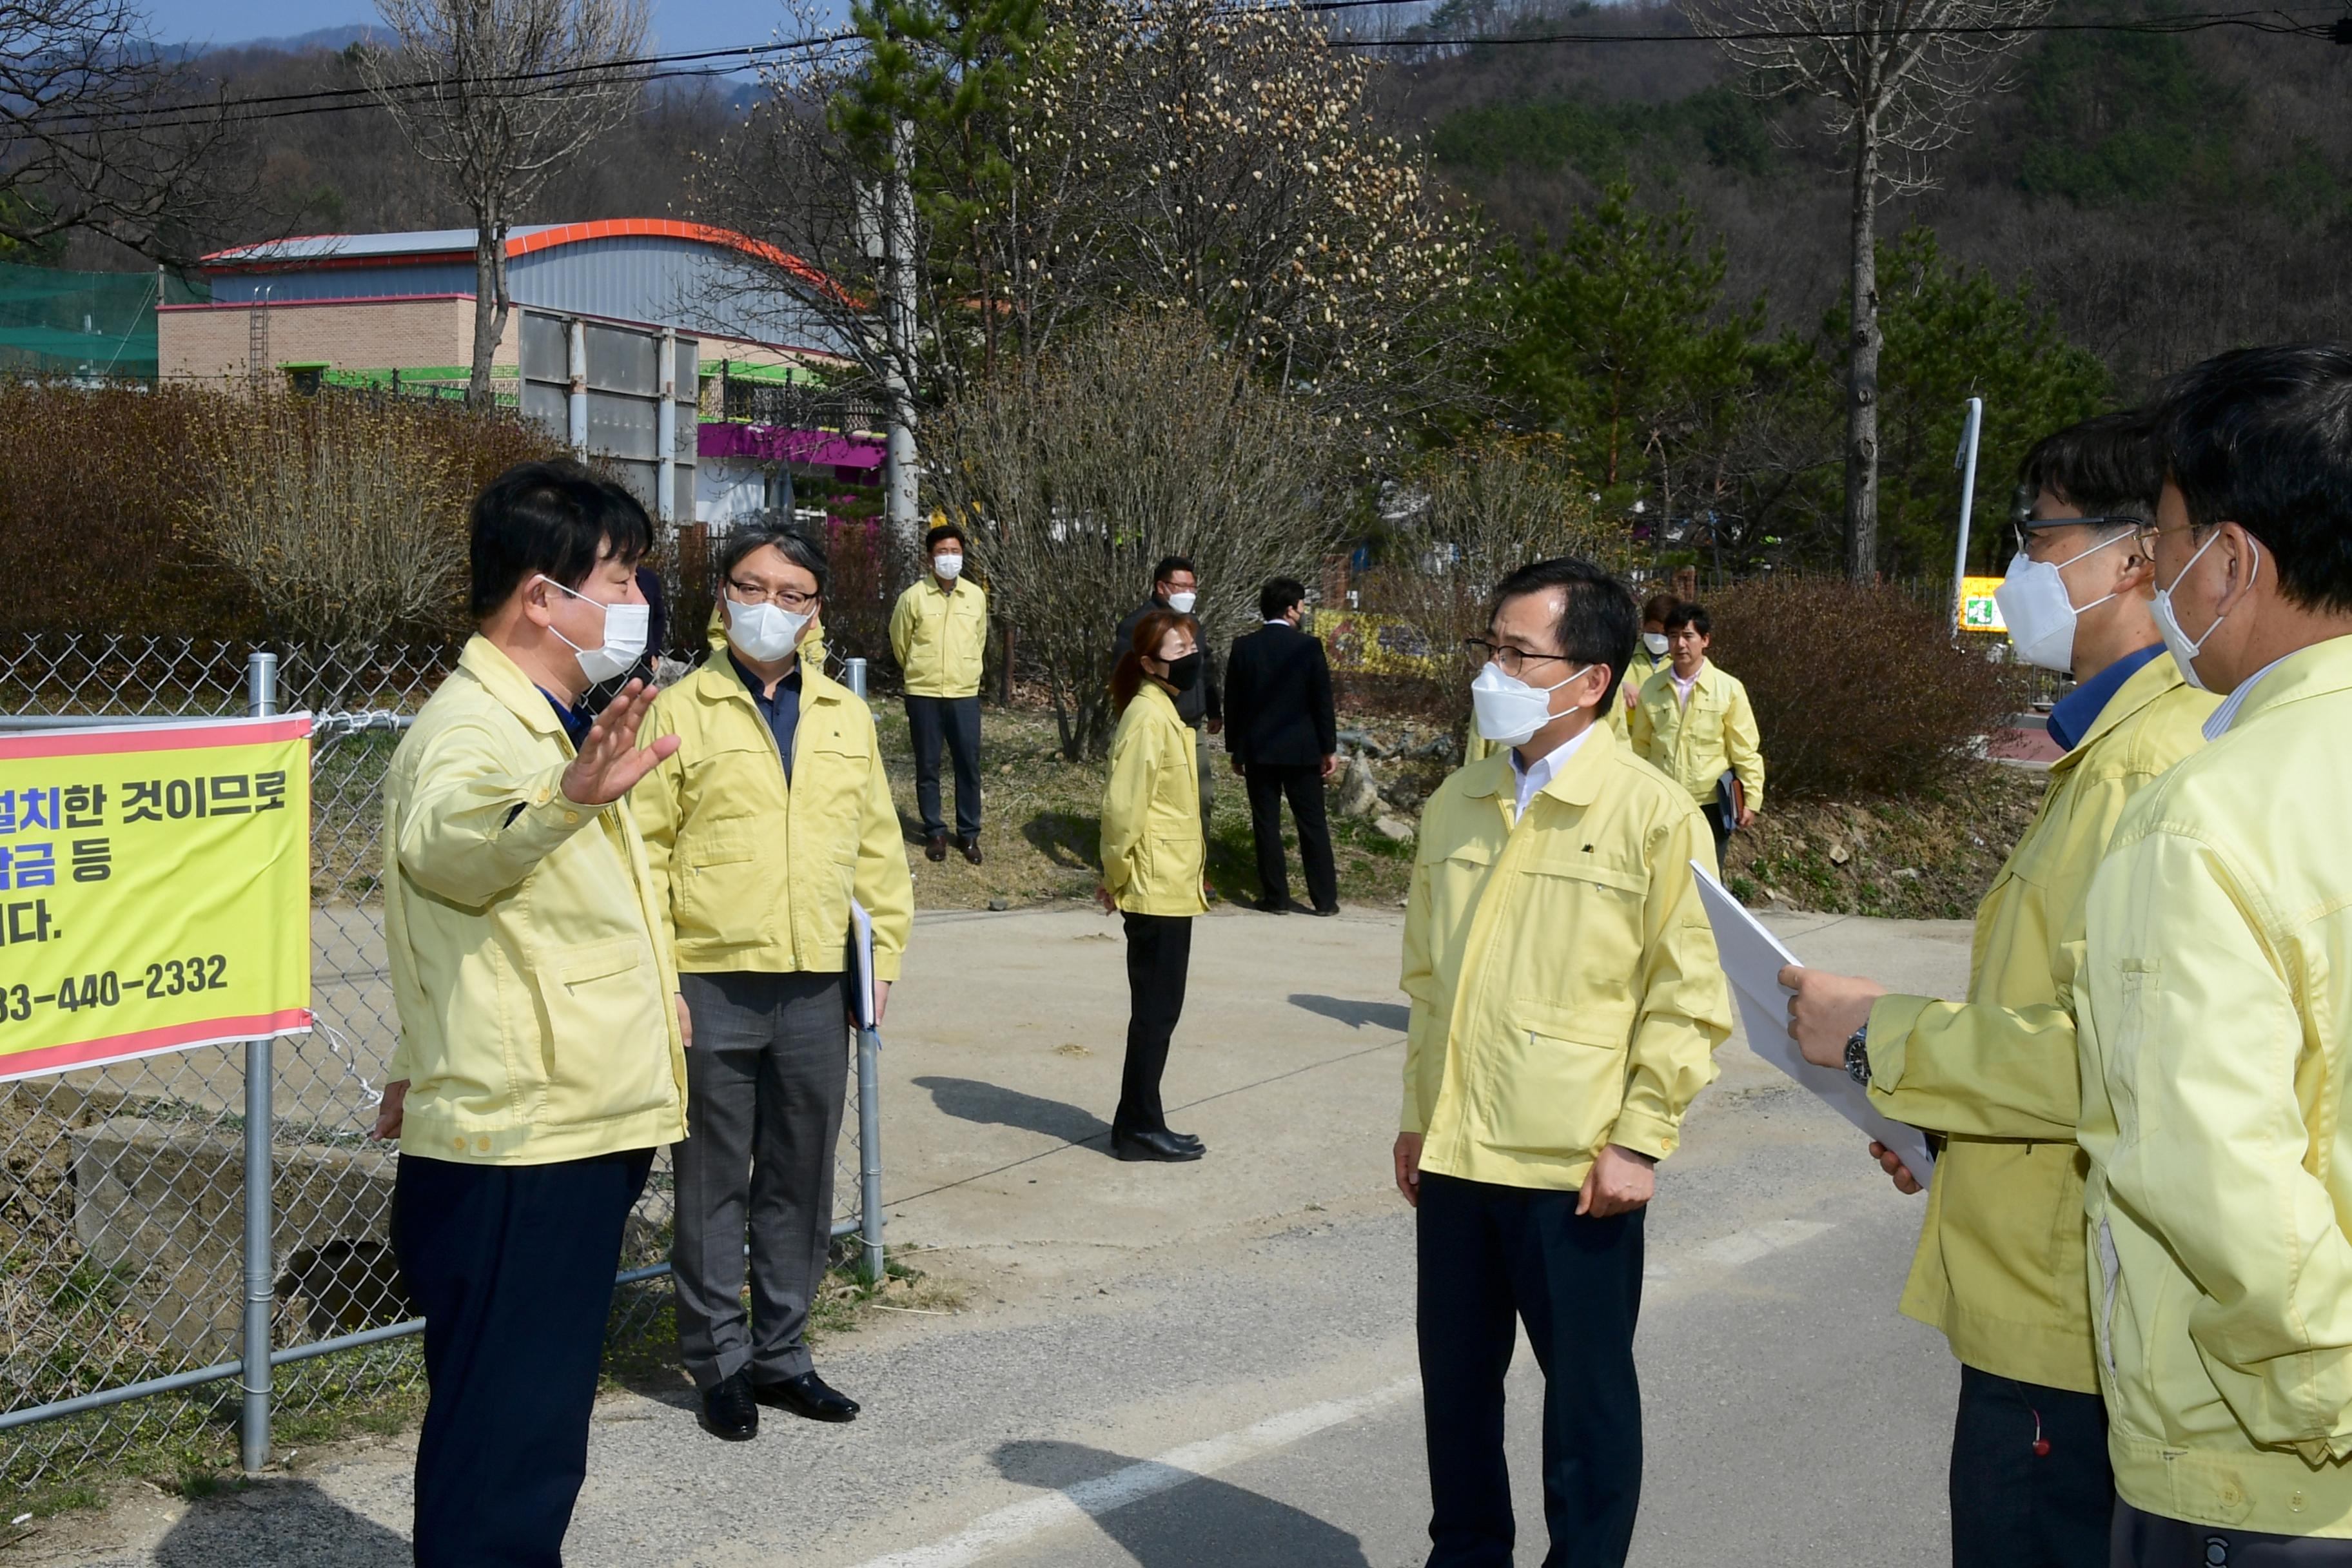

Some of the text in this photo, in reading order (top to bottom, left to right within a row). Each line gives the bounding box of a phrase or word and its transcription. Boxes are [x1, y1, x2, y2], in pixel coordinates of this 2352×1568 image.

[121, 770, 286, 823] 것이므로
[72, 838, 112, 883] 등
[0, 899, 62, 946] 다.
